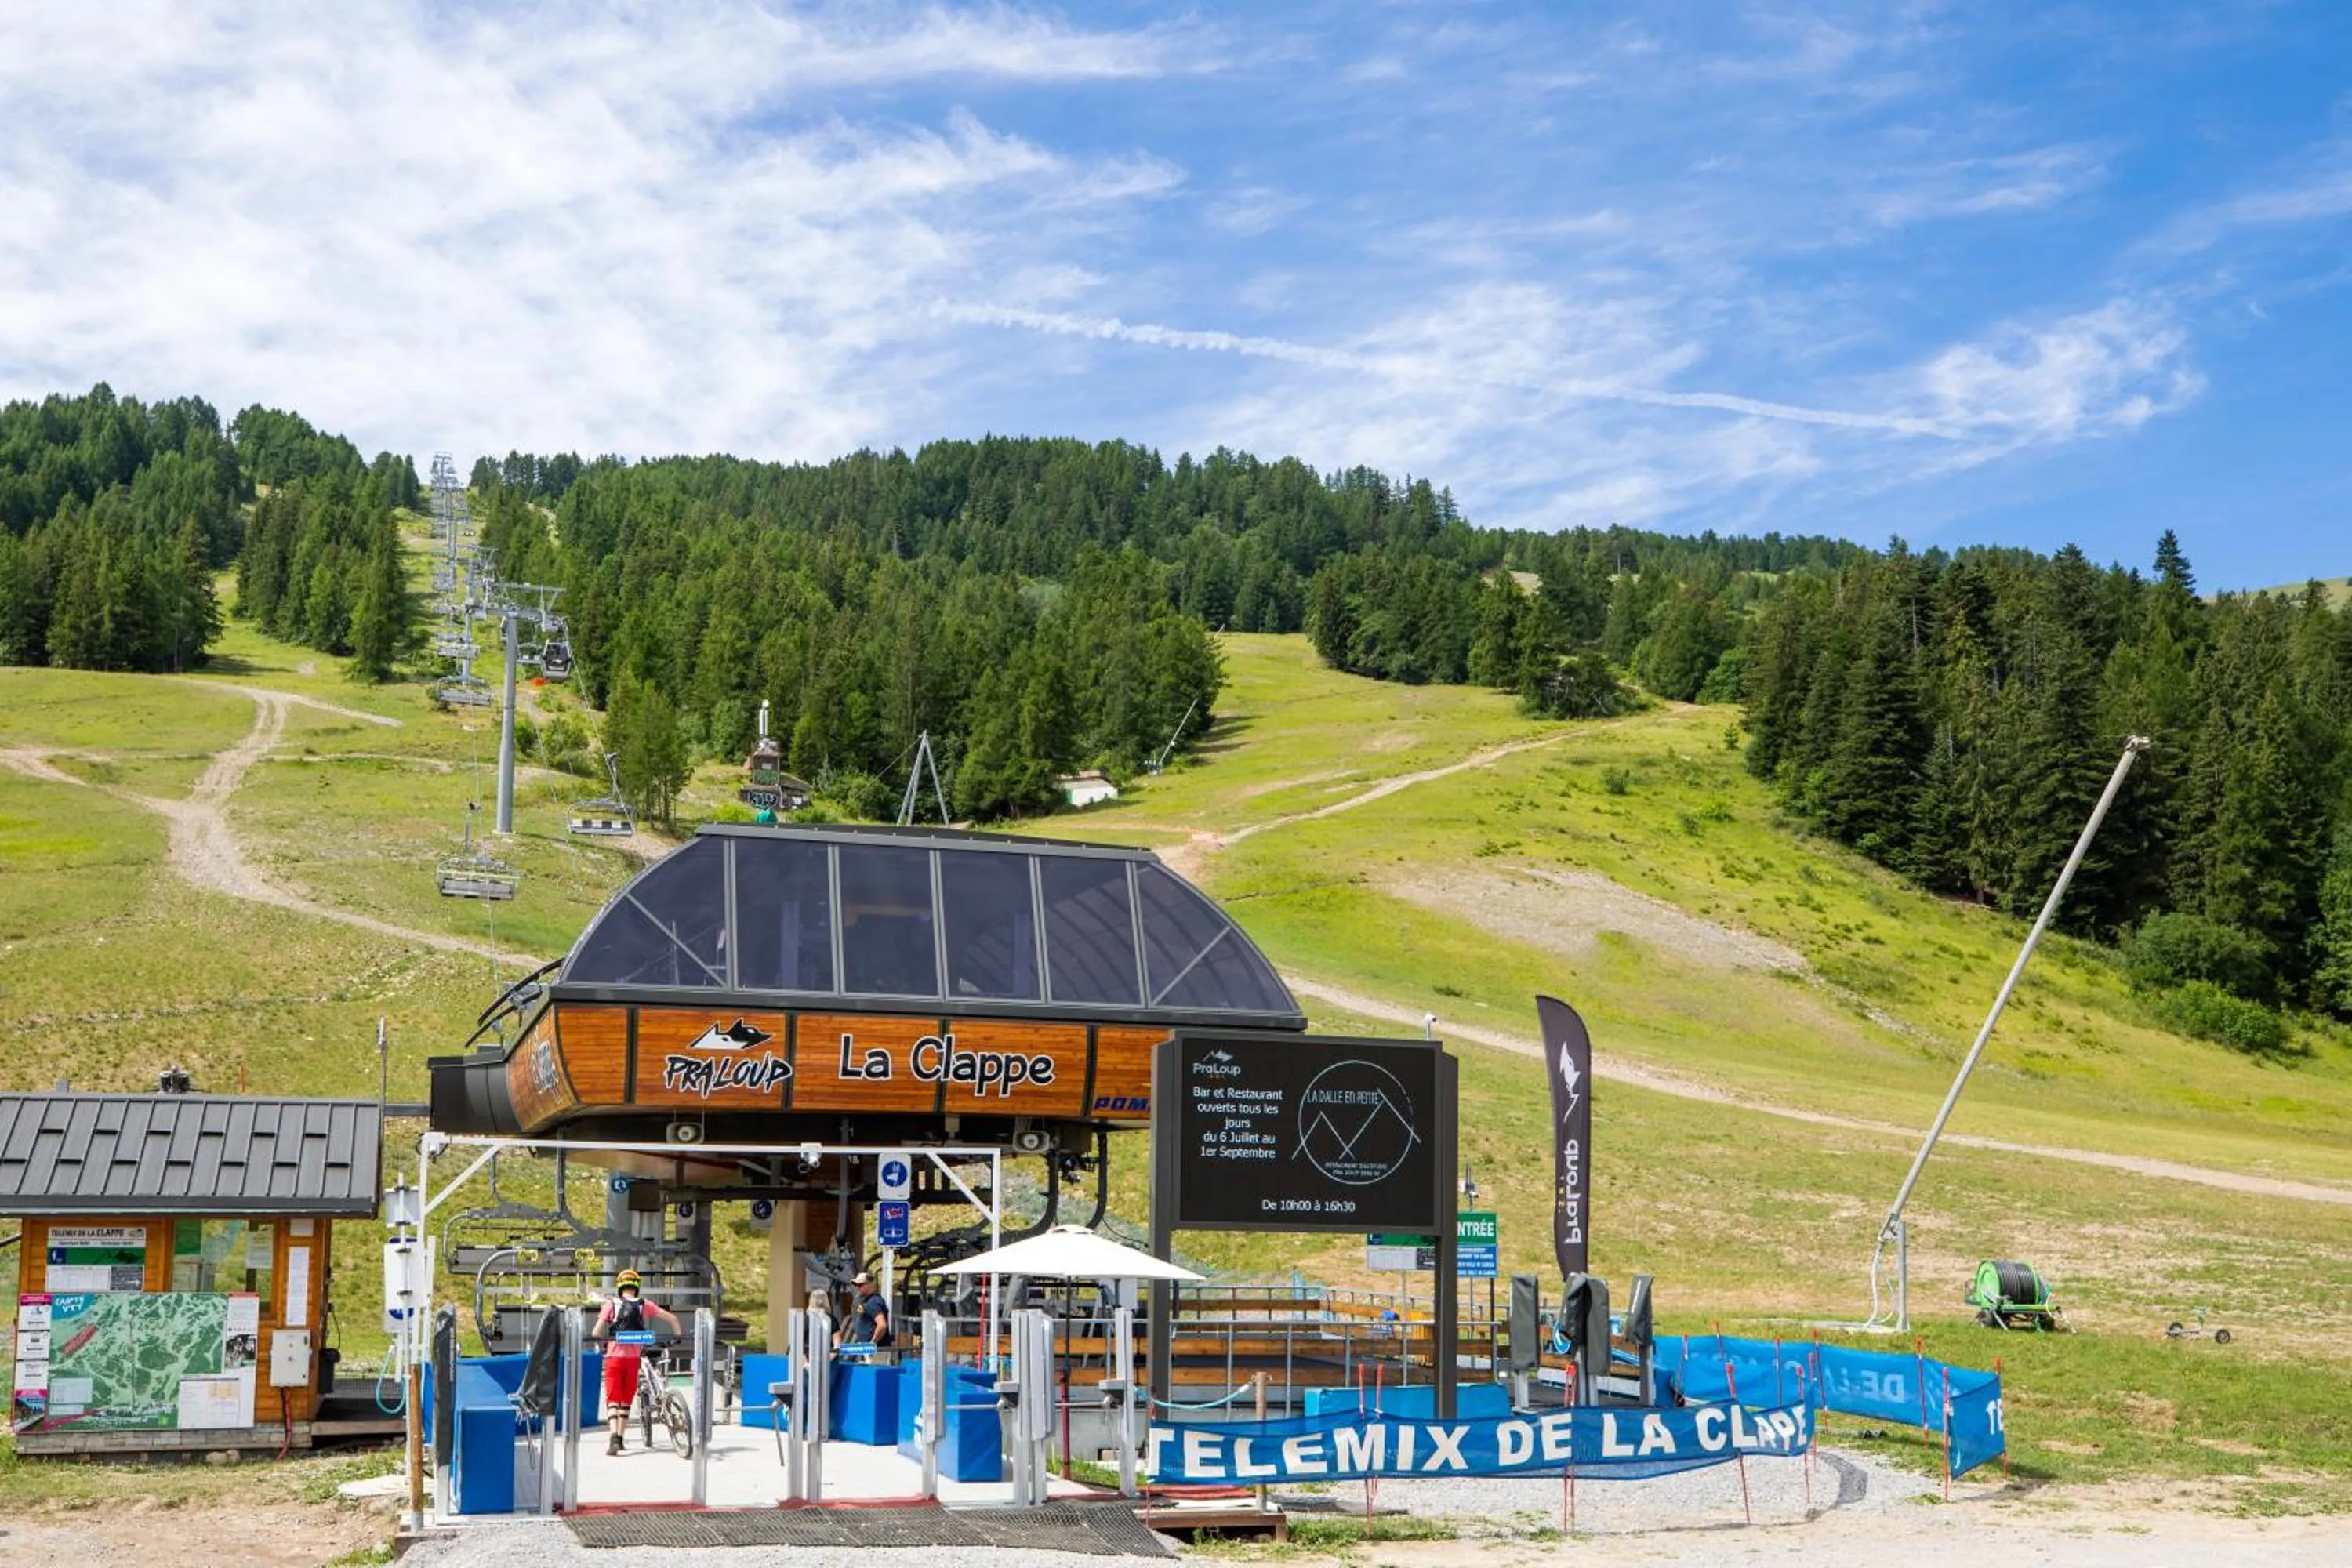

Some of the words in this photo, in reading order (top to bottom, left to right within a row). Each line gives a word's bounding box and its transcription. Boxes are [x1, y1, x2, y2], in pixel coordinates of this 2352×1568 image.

[838, 1033, 892, 1081] La
[910, 1033, 1056, 1098] Clappe
[1192, 1062, 1241, 1076] PraLoup
[1192, 1086, 1210, 1098] Bar
[1213, 1087, 1225, 1098] et
[1227, 1087, 1283, 1100] Restaurant
[1197, 1102, 1236, 1112] ouverts
[1239, 1103, 1261, 1114] tous
[1264, 1103, 1279, 1114] les
[1224, 1116, 1251, 1130] jours
[1203, 1131, 1217, 1142] du
[1219, 1131, 1227, 1142] 6
[1229, 1131, 1260, 1143] Juillet
[1262, 1134, 1276, 1144] au
[1200, 1145, 1217, 1156] 1er
[1219, 1145, 1276, 1159] Septembre
[1261, 1199, 1277, 1210] De
[1280, 1199, 1312, 1211] 10h00
[1314, 1199, 1321, 1211] à
[1324, 1200, 1356, 1213] 16h30
[1149, 1425, 1469, 1478] TELEMIX
[1497, 1414, 1571, 1467] DE
[1602, 1413, 1676, 1457] LA
